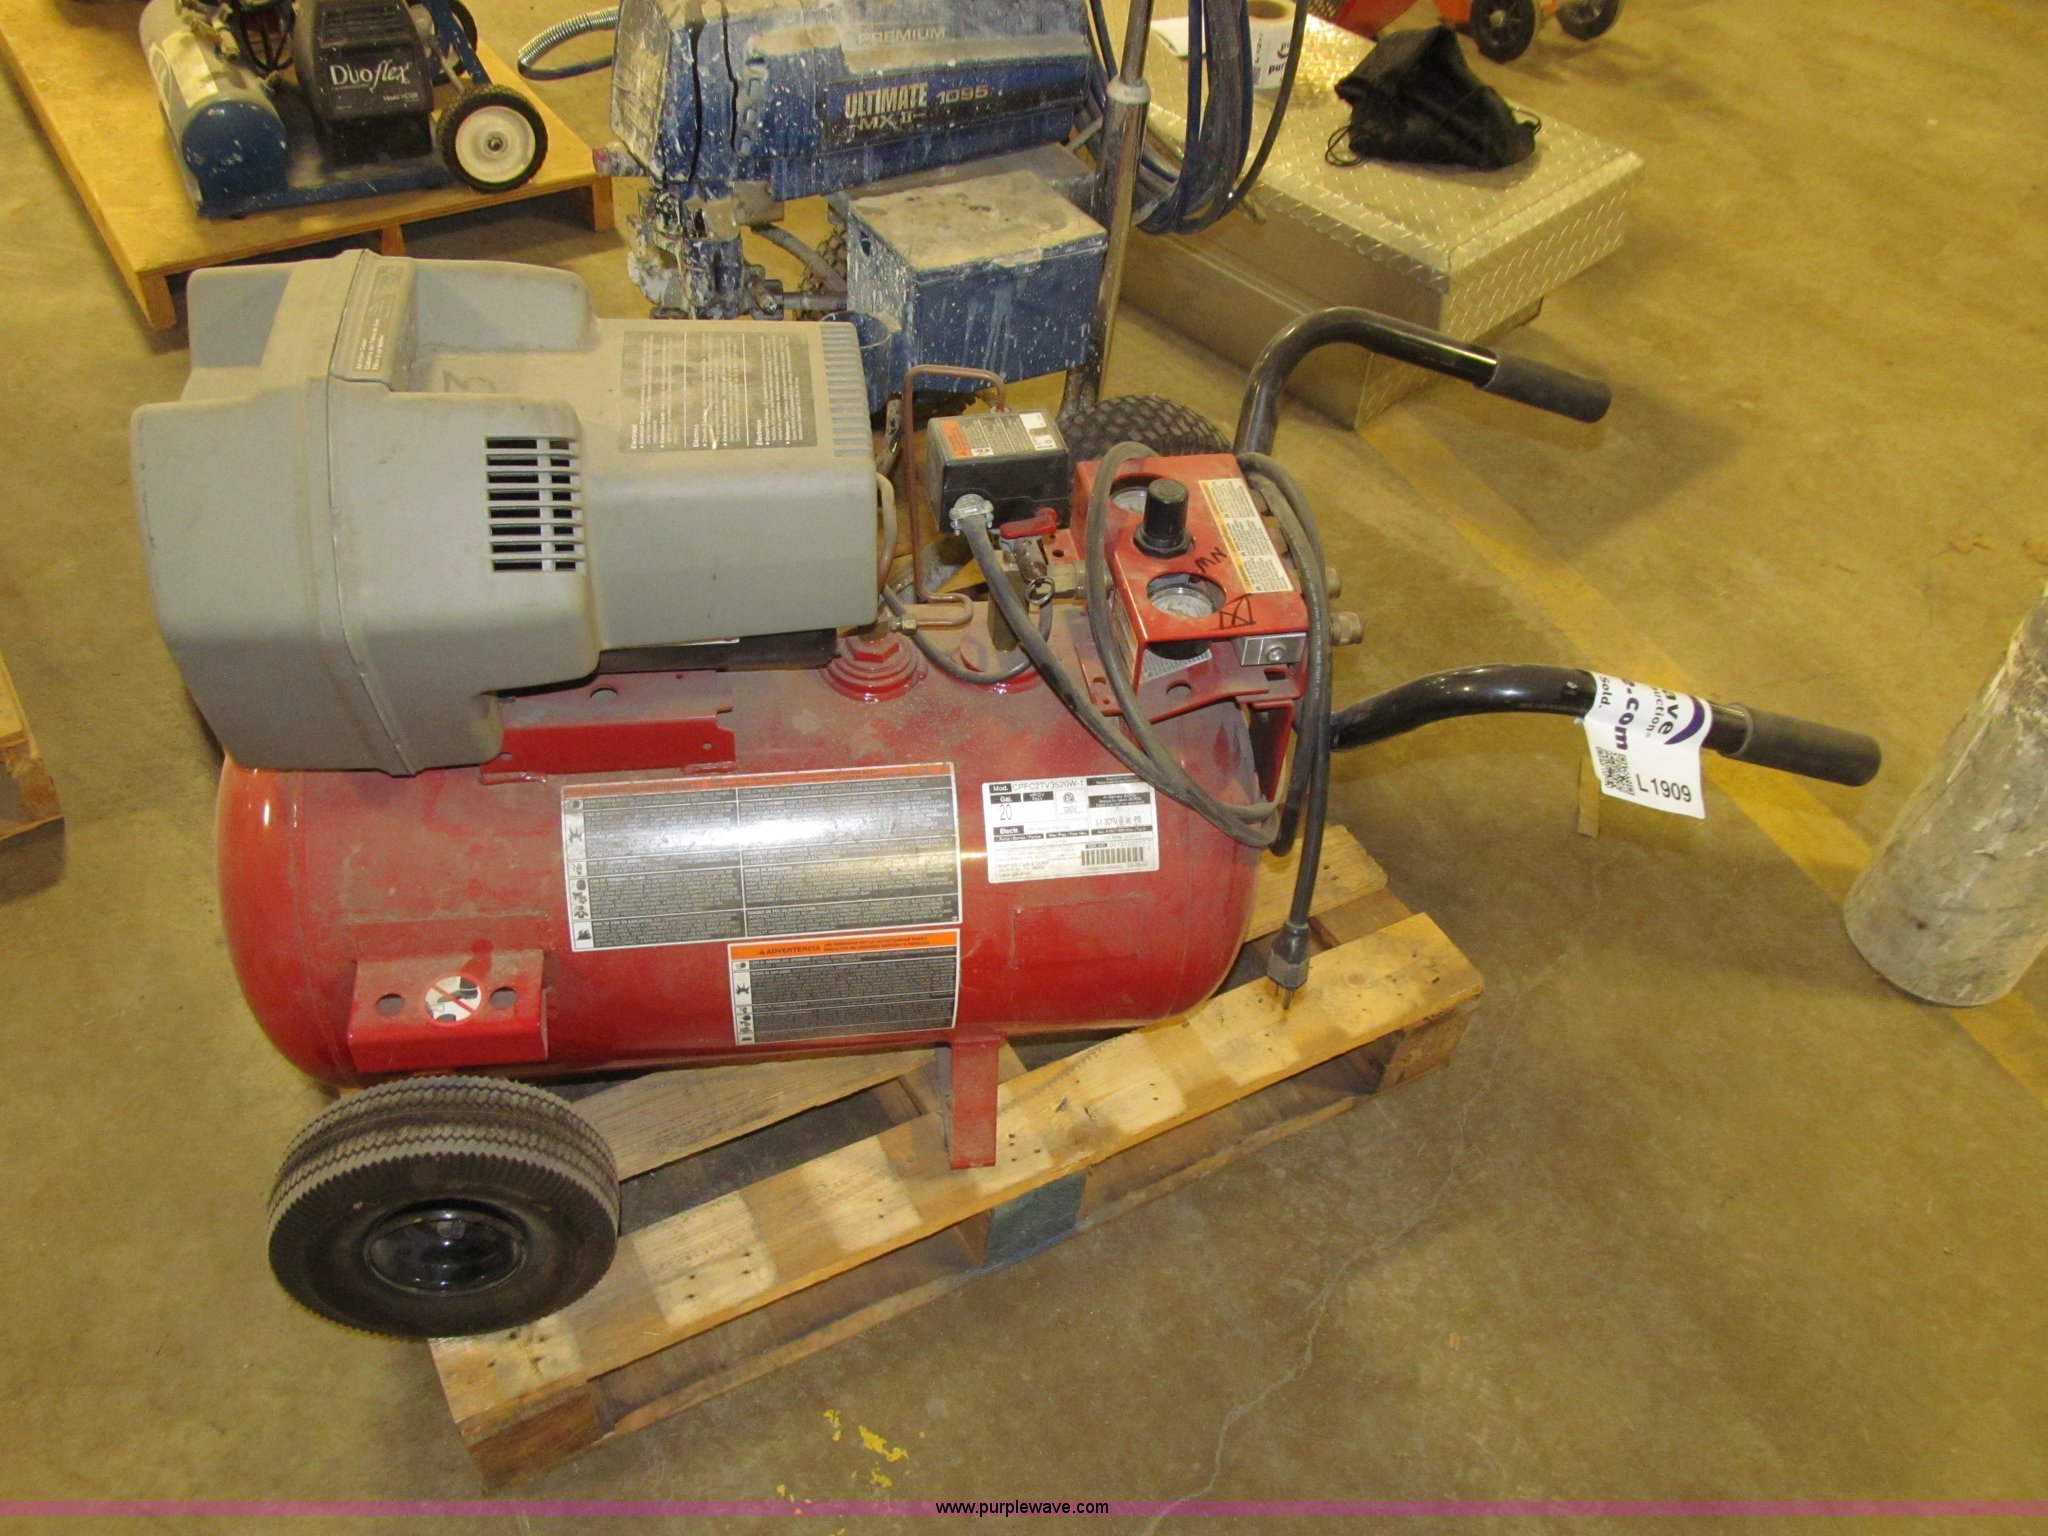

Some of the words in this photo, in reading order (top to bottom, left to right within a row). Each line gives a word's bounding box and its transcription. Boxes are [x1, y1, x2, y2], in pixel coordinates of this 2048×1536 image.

[859, 26, 946, 45] PREMIUM
[844, 82, 928, 119] ULTIMATE
[936, 84, 989, 105] 1095
[993, 784, 1009, 792] Mod.
[999, 804, 1012, 821] 20
